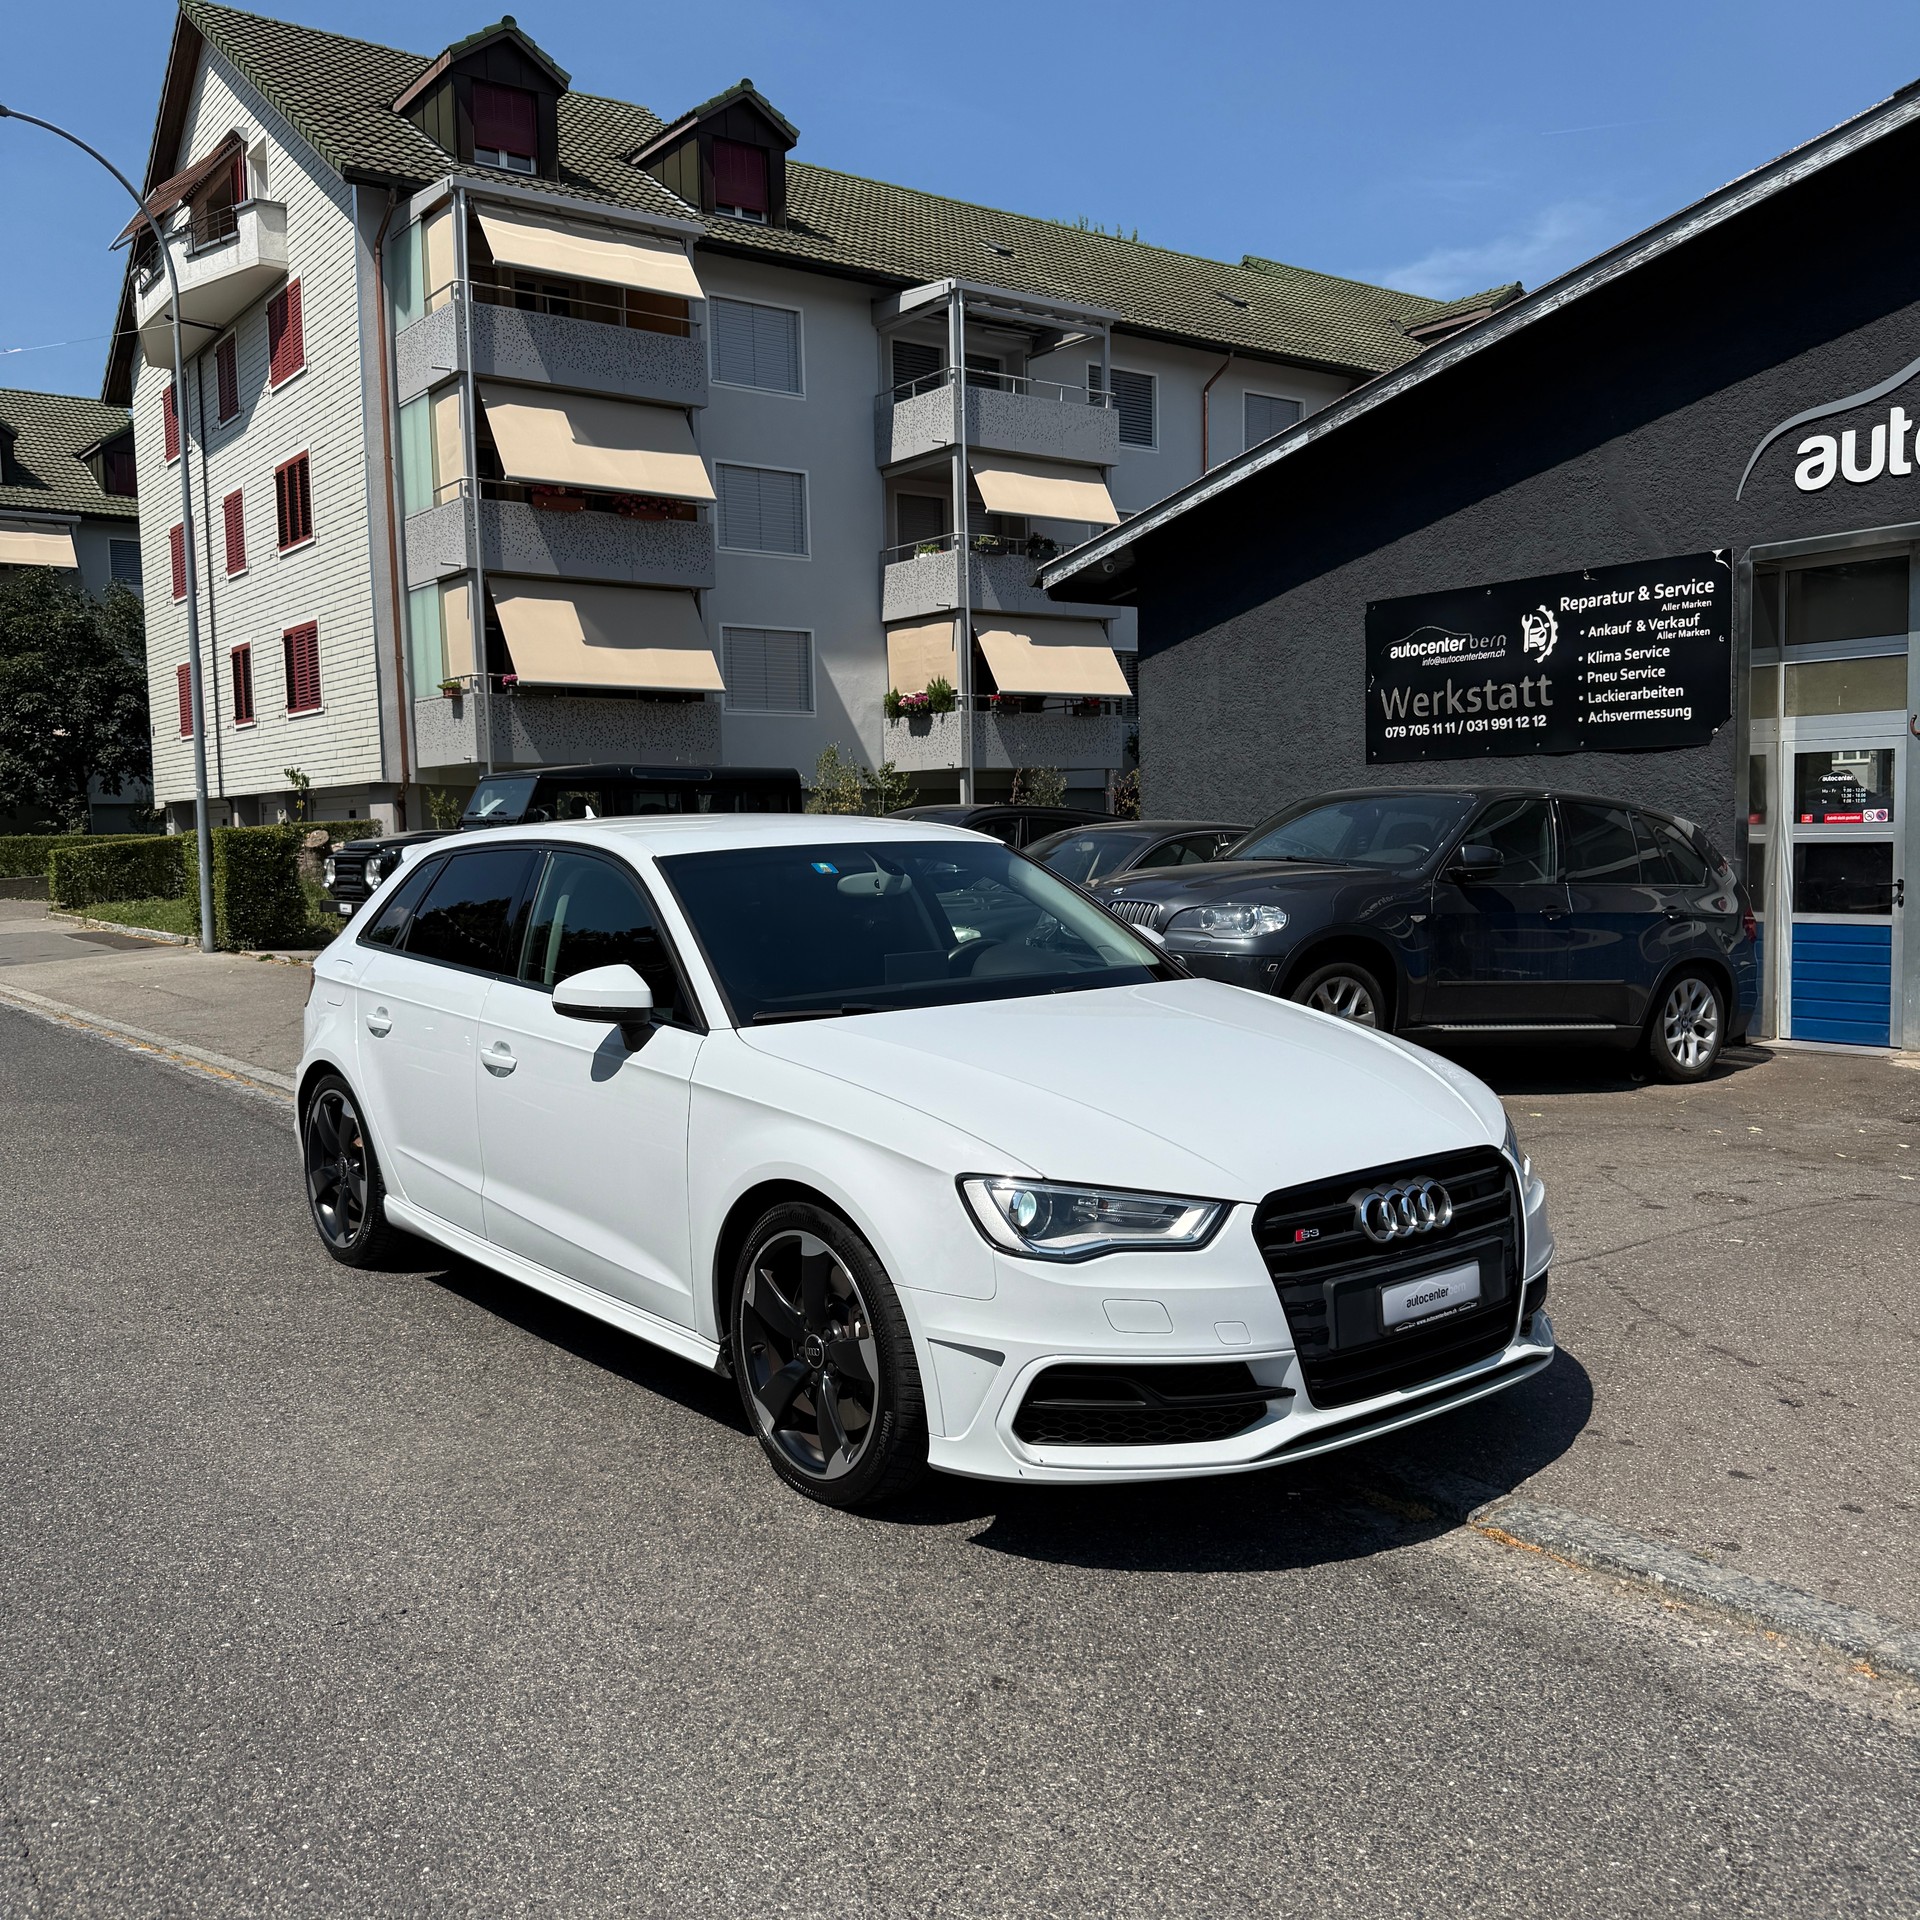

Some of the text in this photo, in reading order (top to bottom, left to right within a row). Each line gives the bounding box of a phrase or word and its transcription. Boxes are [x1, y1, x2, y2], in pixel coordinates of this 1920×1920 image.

[1794, 406, 1920, 491] aut
[1560, 578, 1715, 613] Reparatur & Service
[1661, 599, 1712, 611] Aller Marken
[1588, 613, 1700, 638] Ankauf & Verkauf
[1656, 627, 1711, 640] Aller Marken
[1422, 648, 1506, 666] info@autocenterbern.ch
[1587, 644, 1671, 664] Klima Service
[1587, 665, 1666, 683] Pneu Service
[1380, 674, 1553, 720] Werkstatt
[1588, 685, 1684, 704] Lackierarbeiten
[1588, 706, 1692, 724] Achsvermessung
[1385, 726, 1406, 738] 079
[1408, 724, 1430, 737] 705
[1466, 718, 1488, 732] 031
[1491, 717, 1513, 730] 991
[1515, 716, 1530, 729] 12
[1532, 715, 1547, 727] 12
